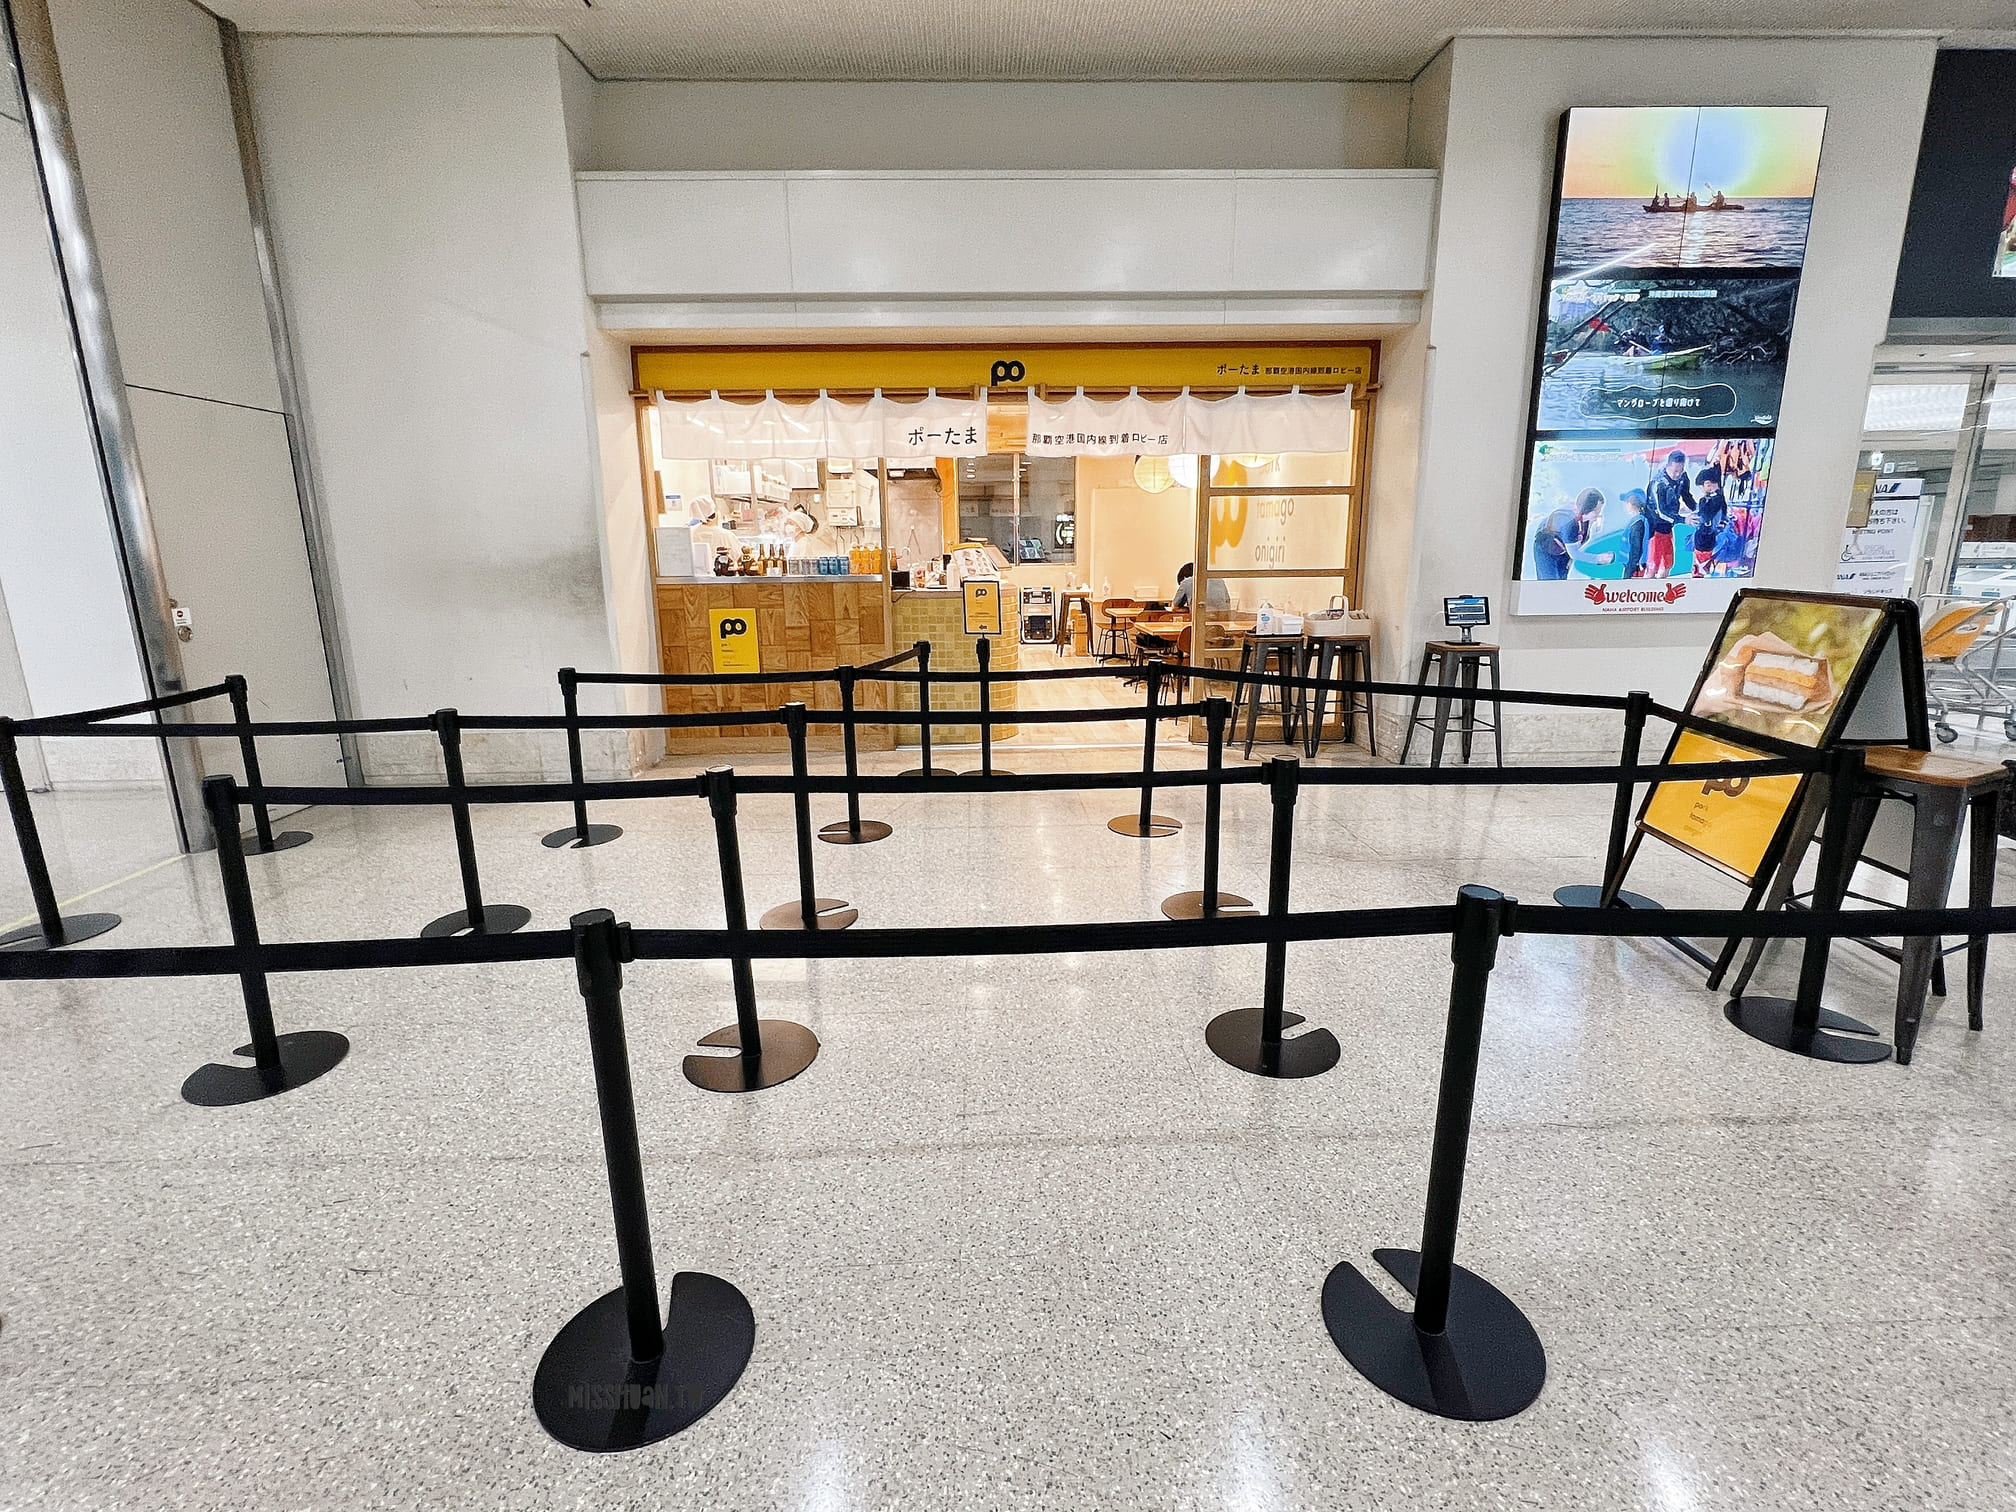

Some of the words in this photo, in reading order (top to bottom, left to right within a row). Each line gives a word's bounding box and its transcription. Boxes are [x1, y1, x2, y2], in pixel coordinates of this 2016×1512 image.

[990, 360, 1026, 387] po
[1217, 363, 1260, 376] ポーたま
[908, 426, 979, 446] ポーたま
[1031, 432, 1169, 446] 那覇空港国内線到着ロビー店
[1256, 497, 1295, 525] tamago
[1255, 536, 1286, 569] onigiri
[1605, 589, 1665, 603] welcome
[720, 618, 748, 640] po
